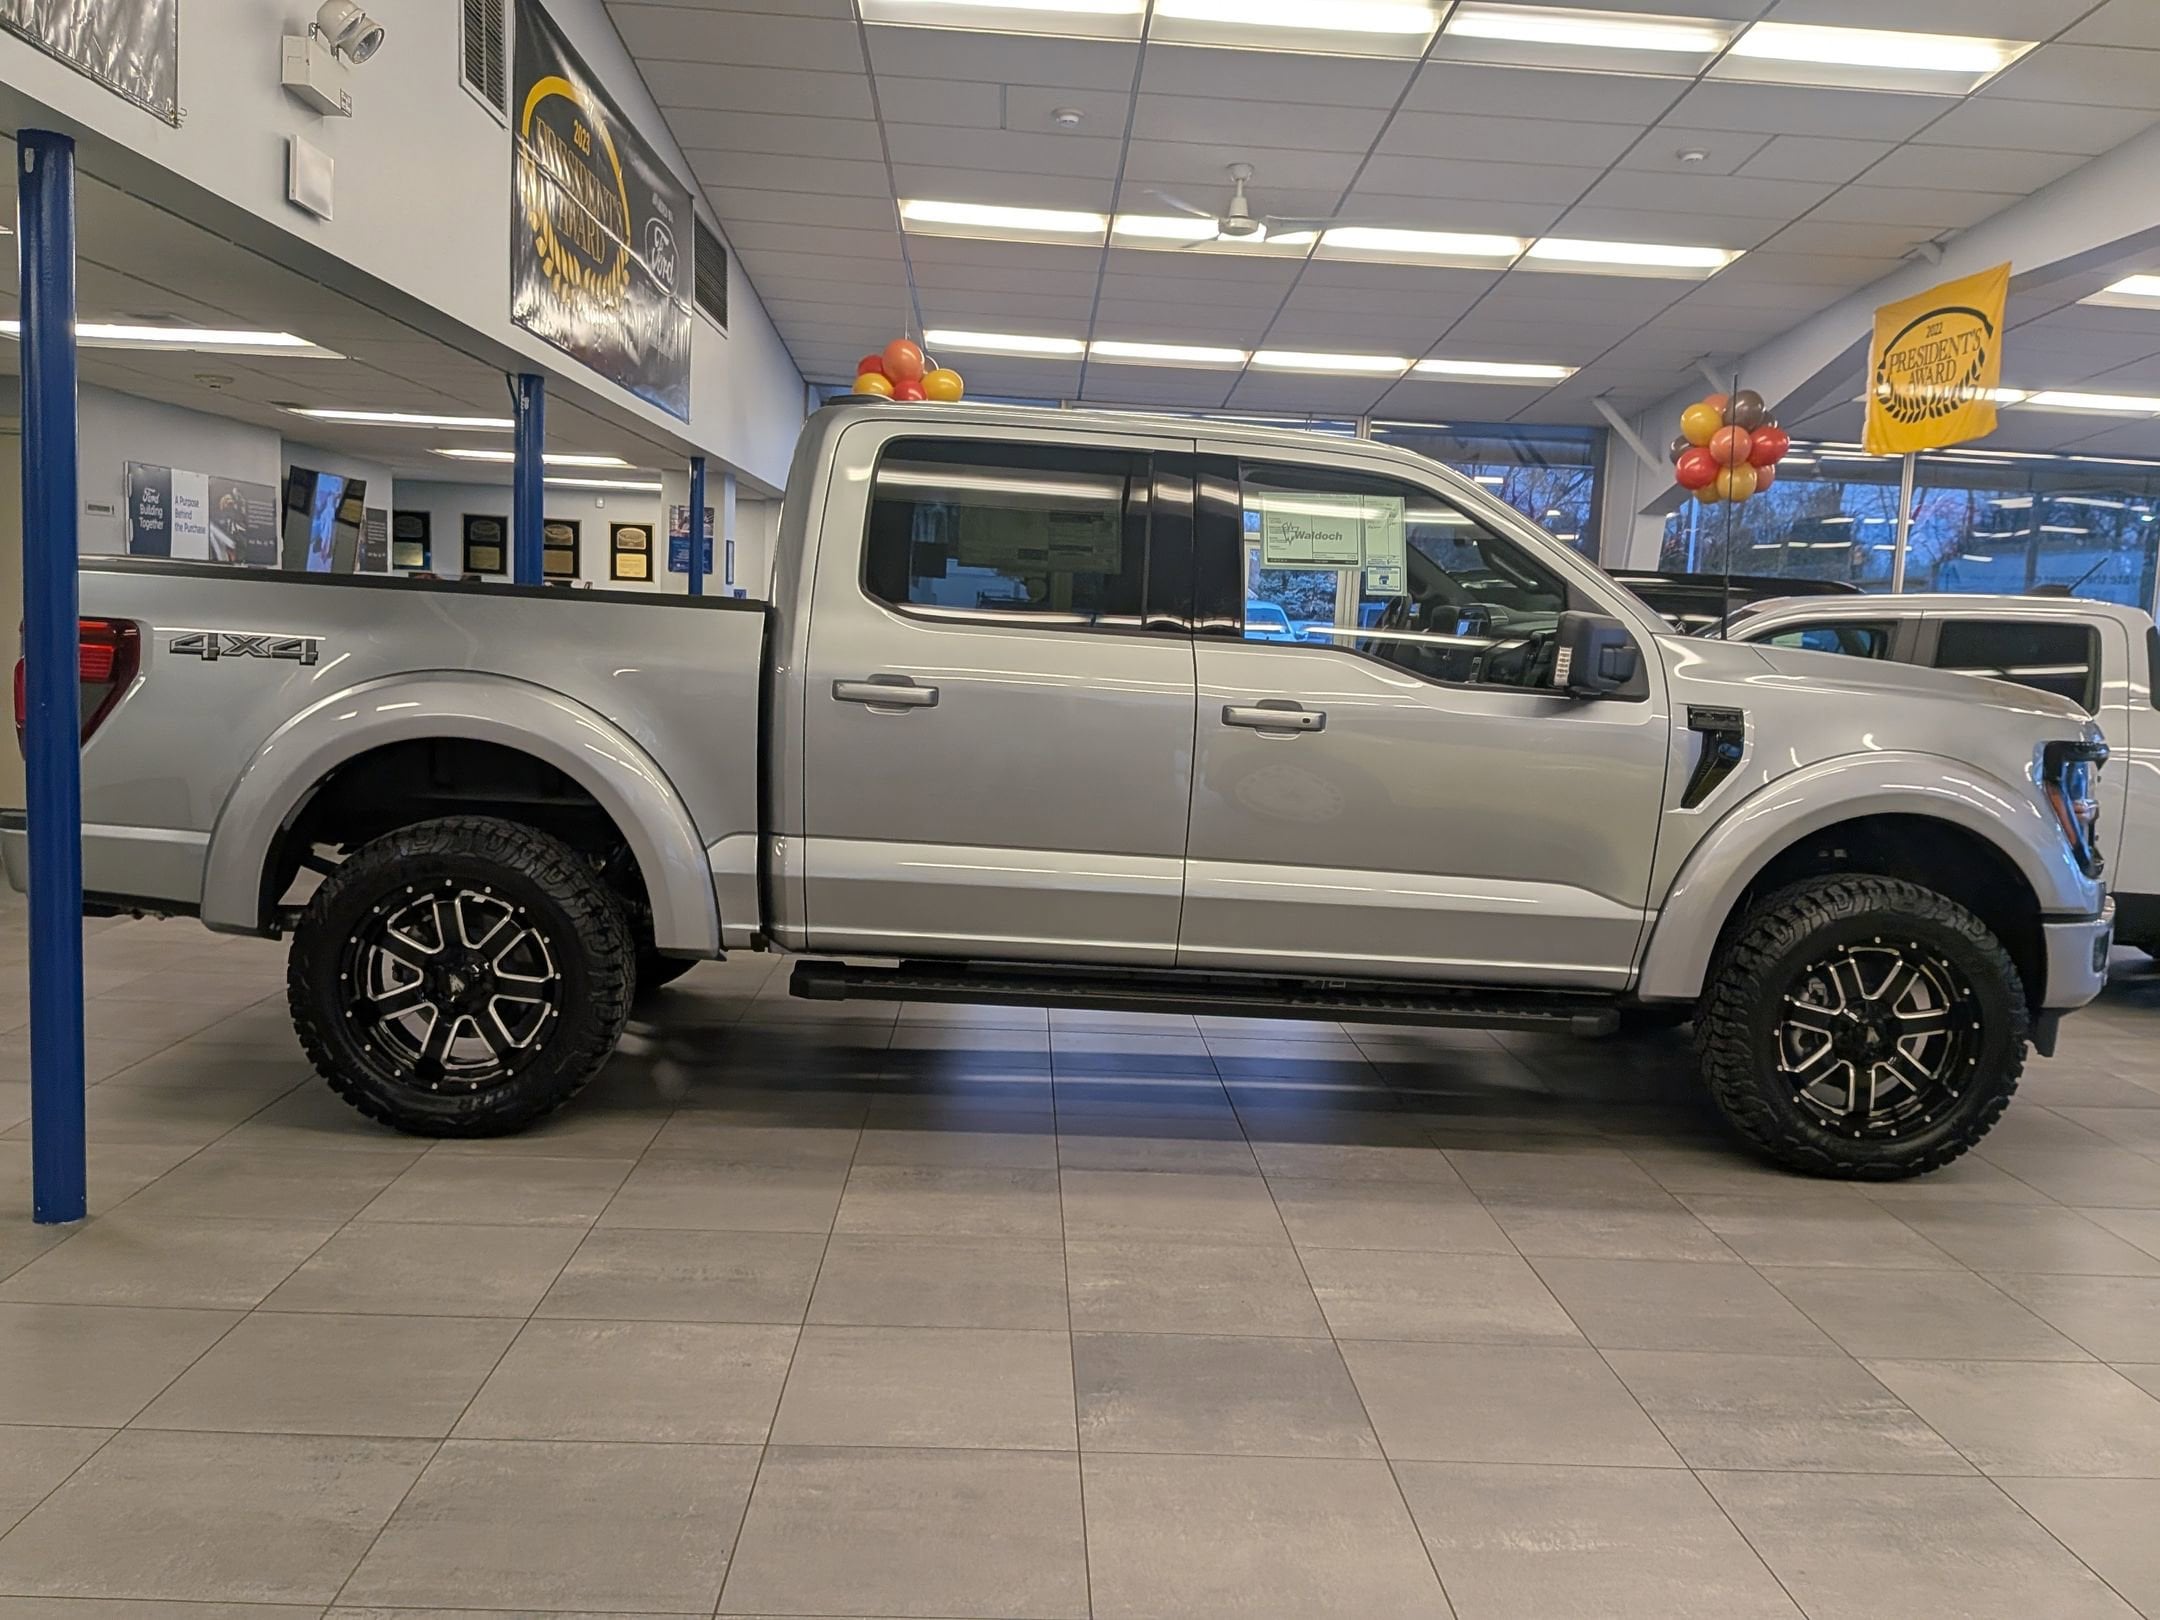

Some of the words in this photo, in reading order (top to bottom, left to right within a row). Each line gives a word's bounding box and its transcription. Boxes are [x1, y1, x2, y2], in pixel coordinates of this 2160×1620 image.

[573, 119, 591, 156] 2023
[536, 115, 624, 240] PRESIDENT'S
[557, 201, 606, 264] AWARD
[652, 226, 674, 285] Ford
[1926, 322, 1943, 339] 2022
[1889, 328, 1982, 375] PRESIDENT'S
[1909, 360, 1957, 387] AWARD
[143, 487, 160, 504] Ford
[140, 503, 163, 519] Building
[175, 508, 192, 520] Behind
[139, 516, 164, 531] Together
[175, 522, 184, 532] the
[185, 523, 206, 535] Purchase
[1294, 530, 1343, 541] Waldoch
